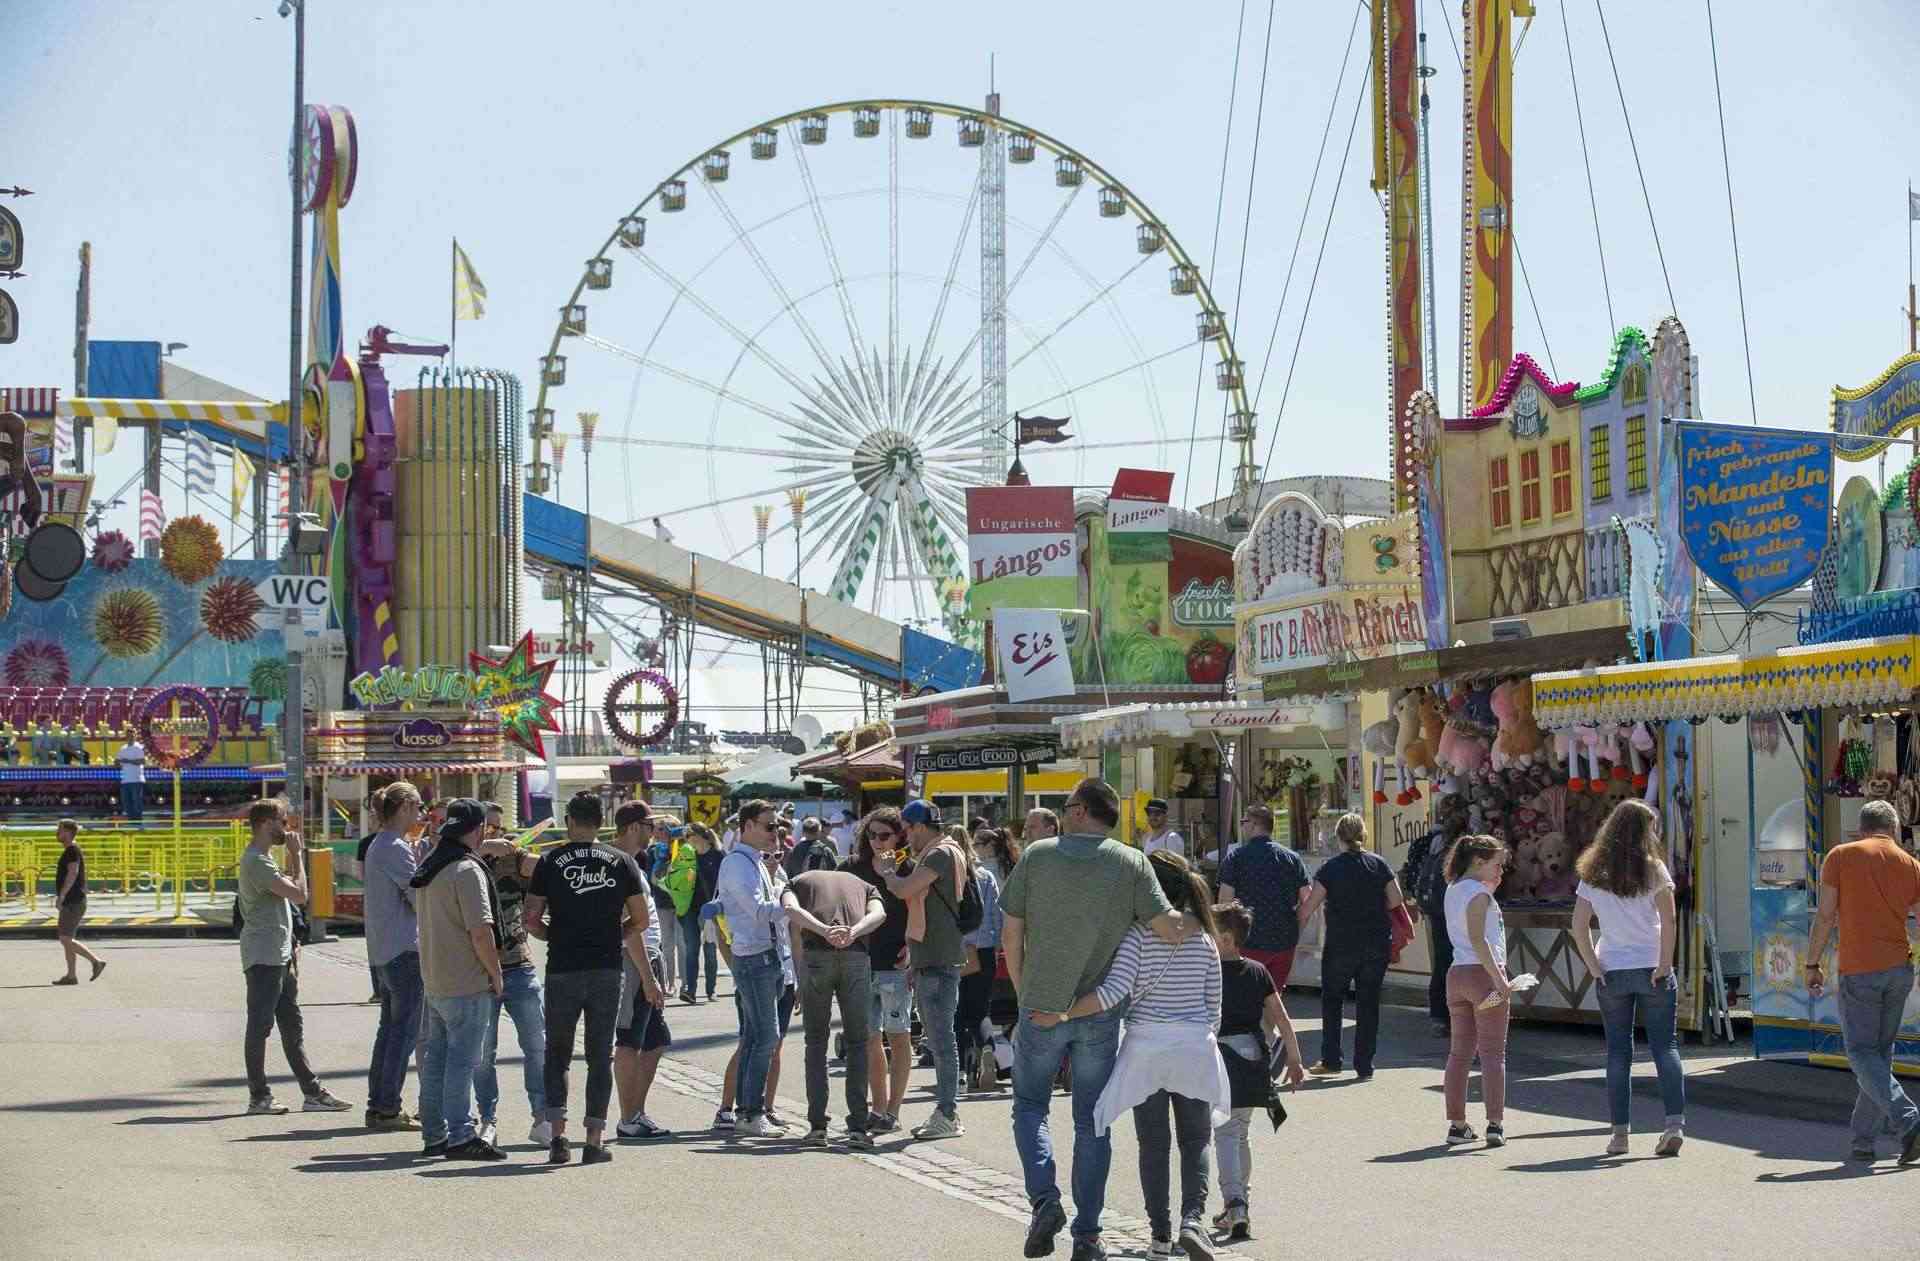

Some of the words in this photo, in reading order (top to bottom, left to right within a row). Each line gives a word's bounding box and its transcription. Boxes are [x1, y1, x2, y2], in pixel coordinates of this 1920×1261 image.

[1687, 440, 1744, 469] frisch
[1720, 444, 1820, 478] gebrannte
[1686, 464, 1829, 511] Mandeln
[1746, 496, 1786, 516] und
[979, 518, 1063, 531] Ungarische
[1708, 512, 1801, 545] Nüsse
[972, 537, 1071, 586] Lángos
[1719, 549, 1750, 564] aus
[1756, 537, 1806, 557] aller
[271, 578, 327, 606] WC
[1184, 600, 1233, 619] FOO
[1012, 631, 1054, 665] Eis
[1260, 620, 1284, 661] EIS
[401, 727, 444, 746] kasse
[983, 751, 1014, 762] FOOD
[556, 852, 574, 867] STILL
[575, 848, 589, 858] NOT
[591, 848, 613, 862] GIVING
[563, 865, 616, 895] Fuck
